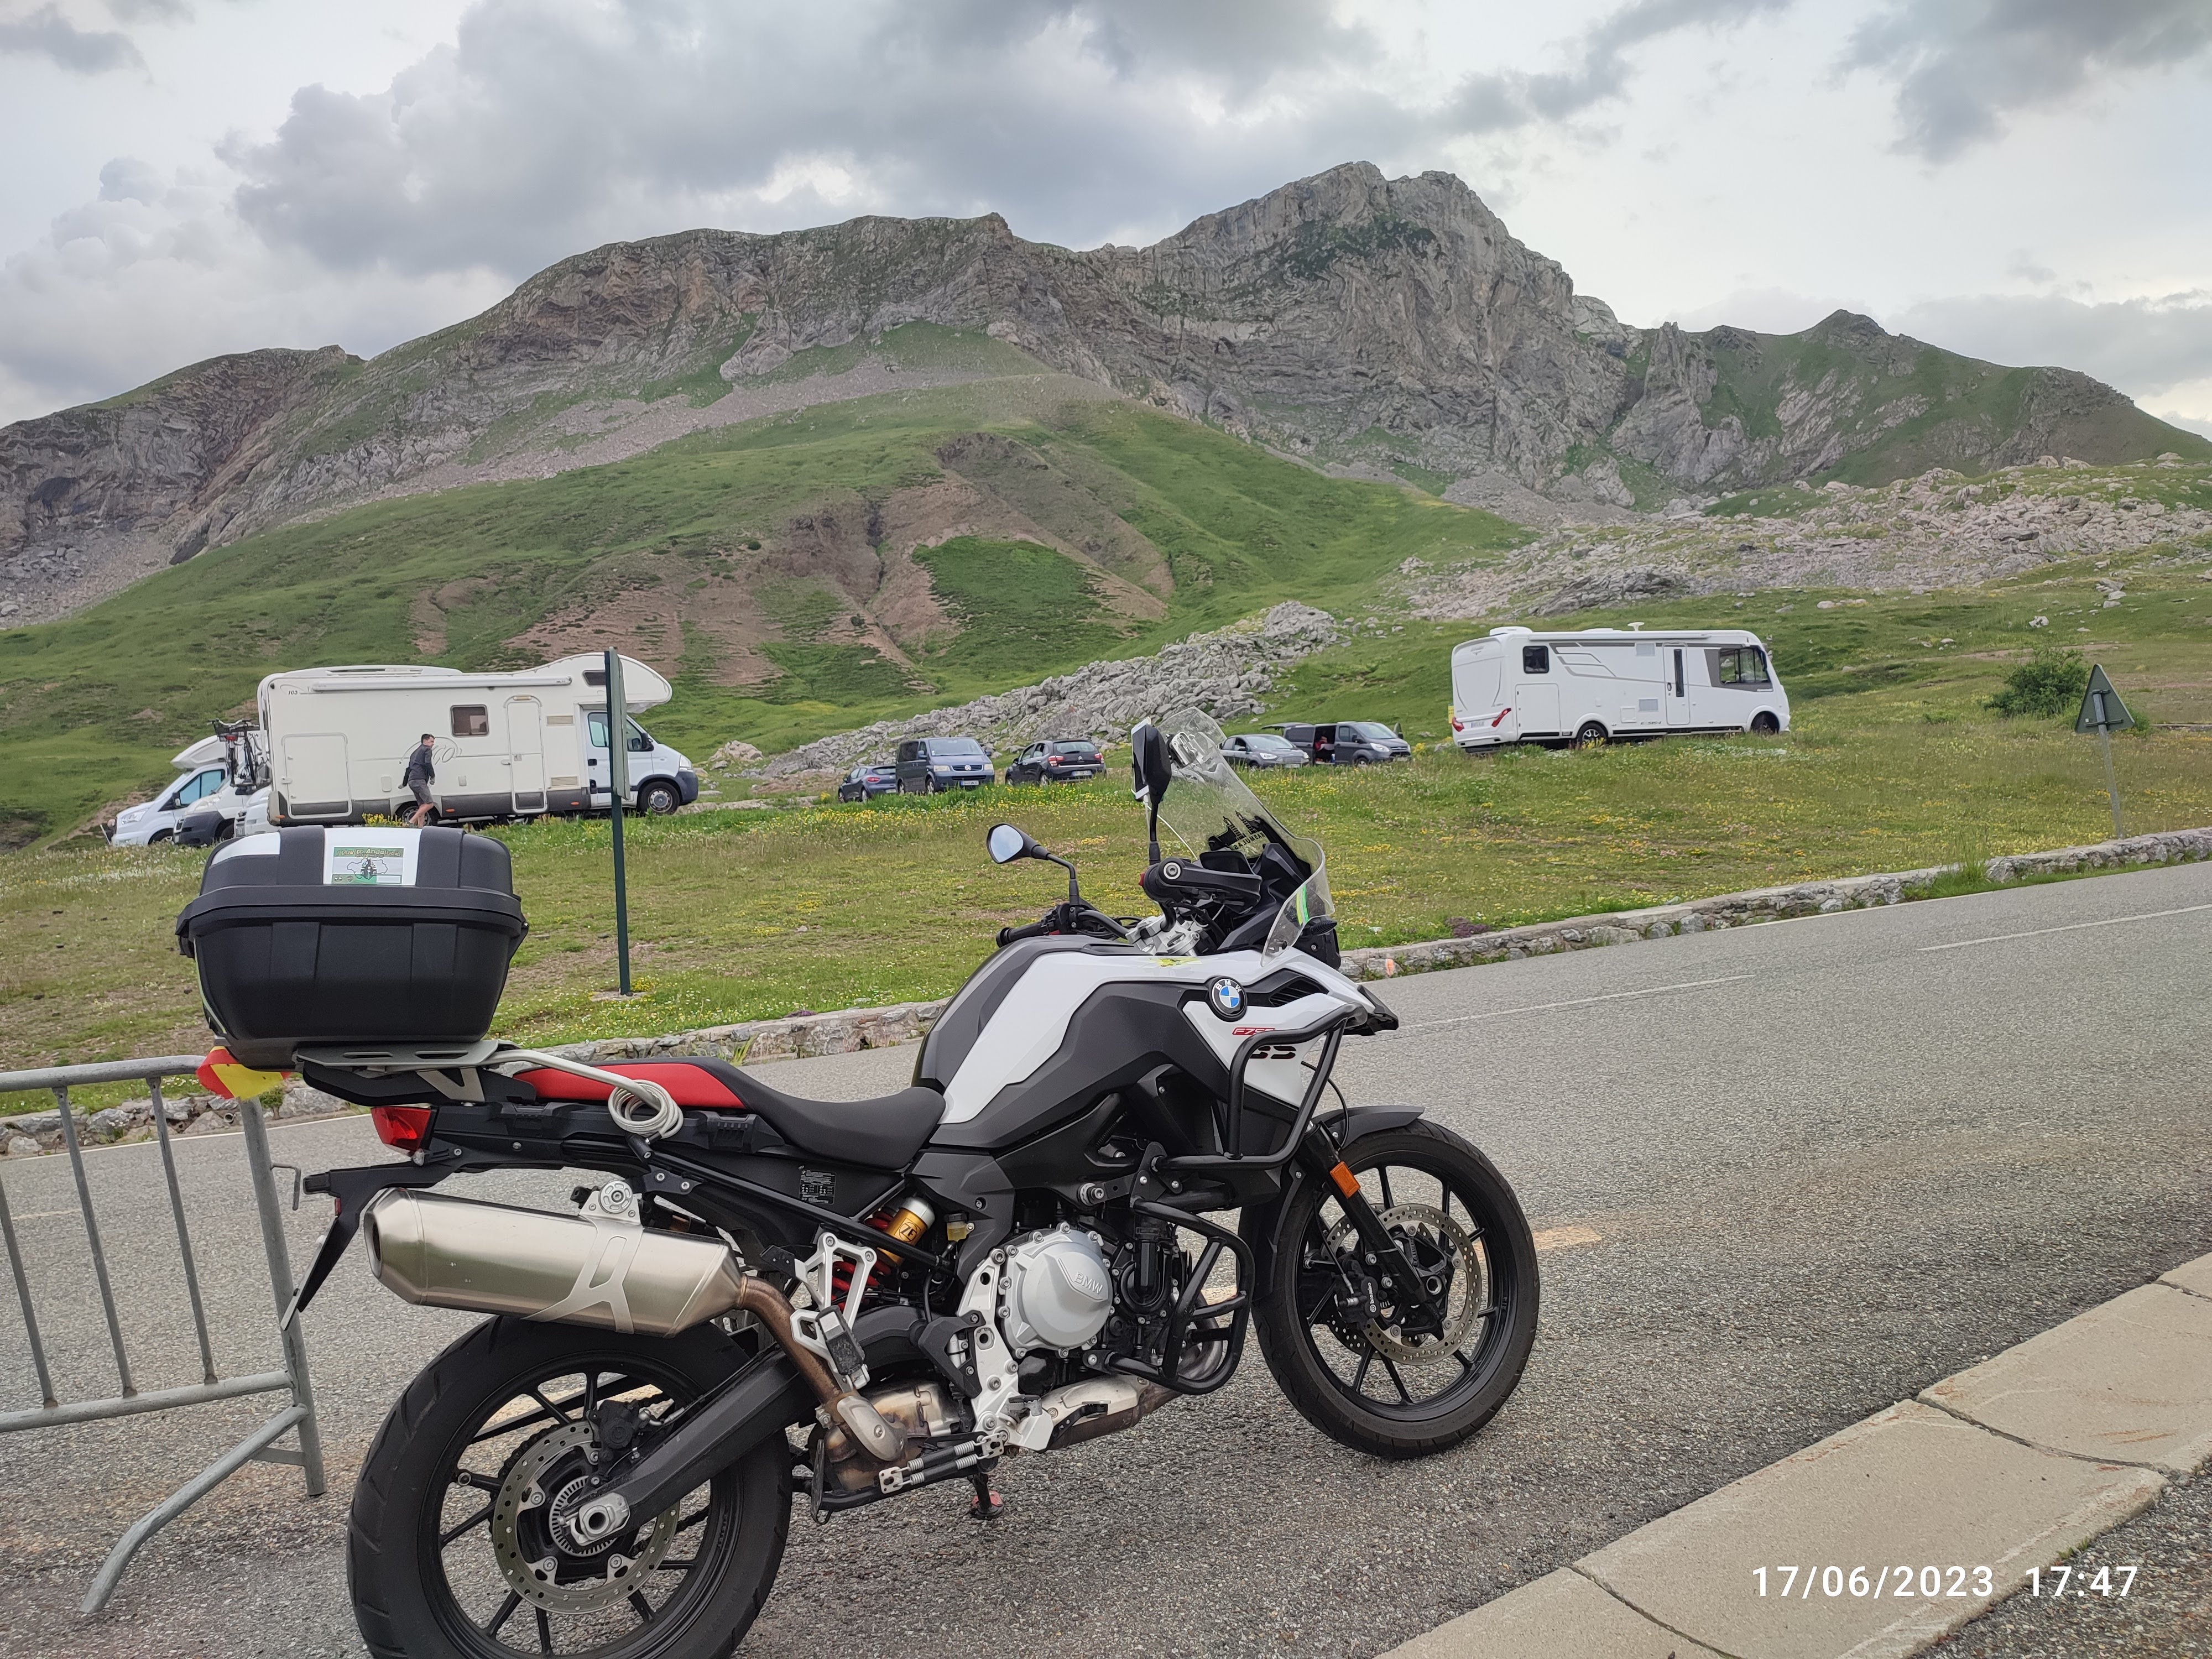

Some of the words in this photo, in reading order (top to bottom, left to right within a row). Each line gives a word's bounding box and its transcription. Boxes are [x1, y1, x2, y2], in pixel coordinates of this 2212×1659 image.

[1215, 980, 1242, 993] BMW
[900, 1223, 917, 1242] ZF
[1074, 1272, 1103, 1295] BMW
